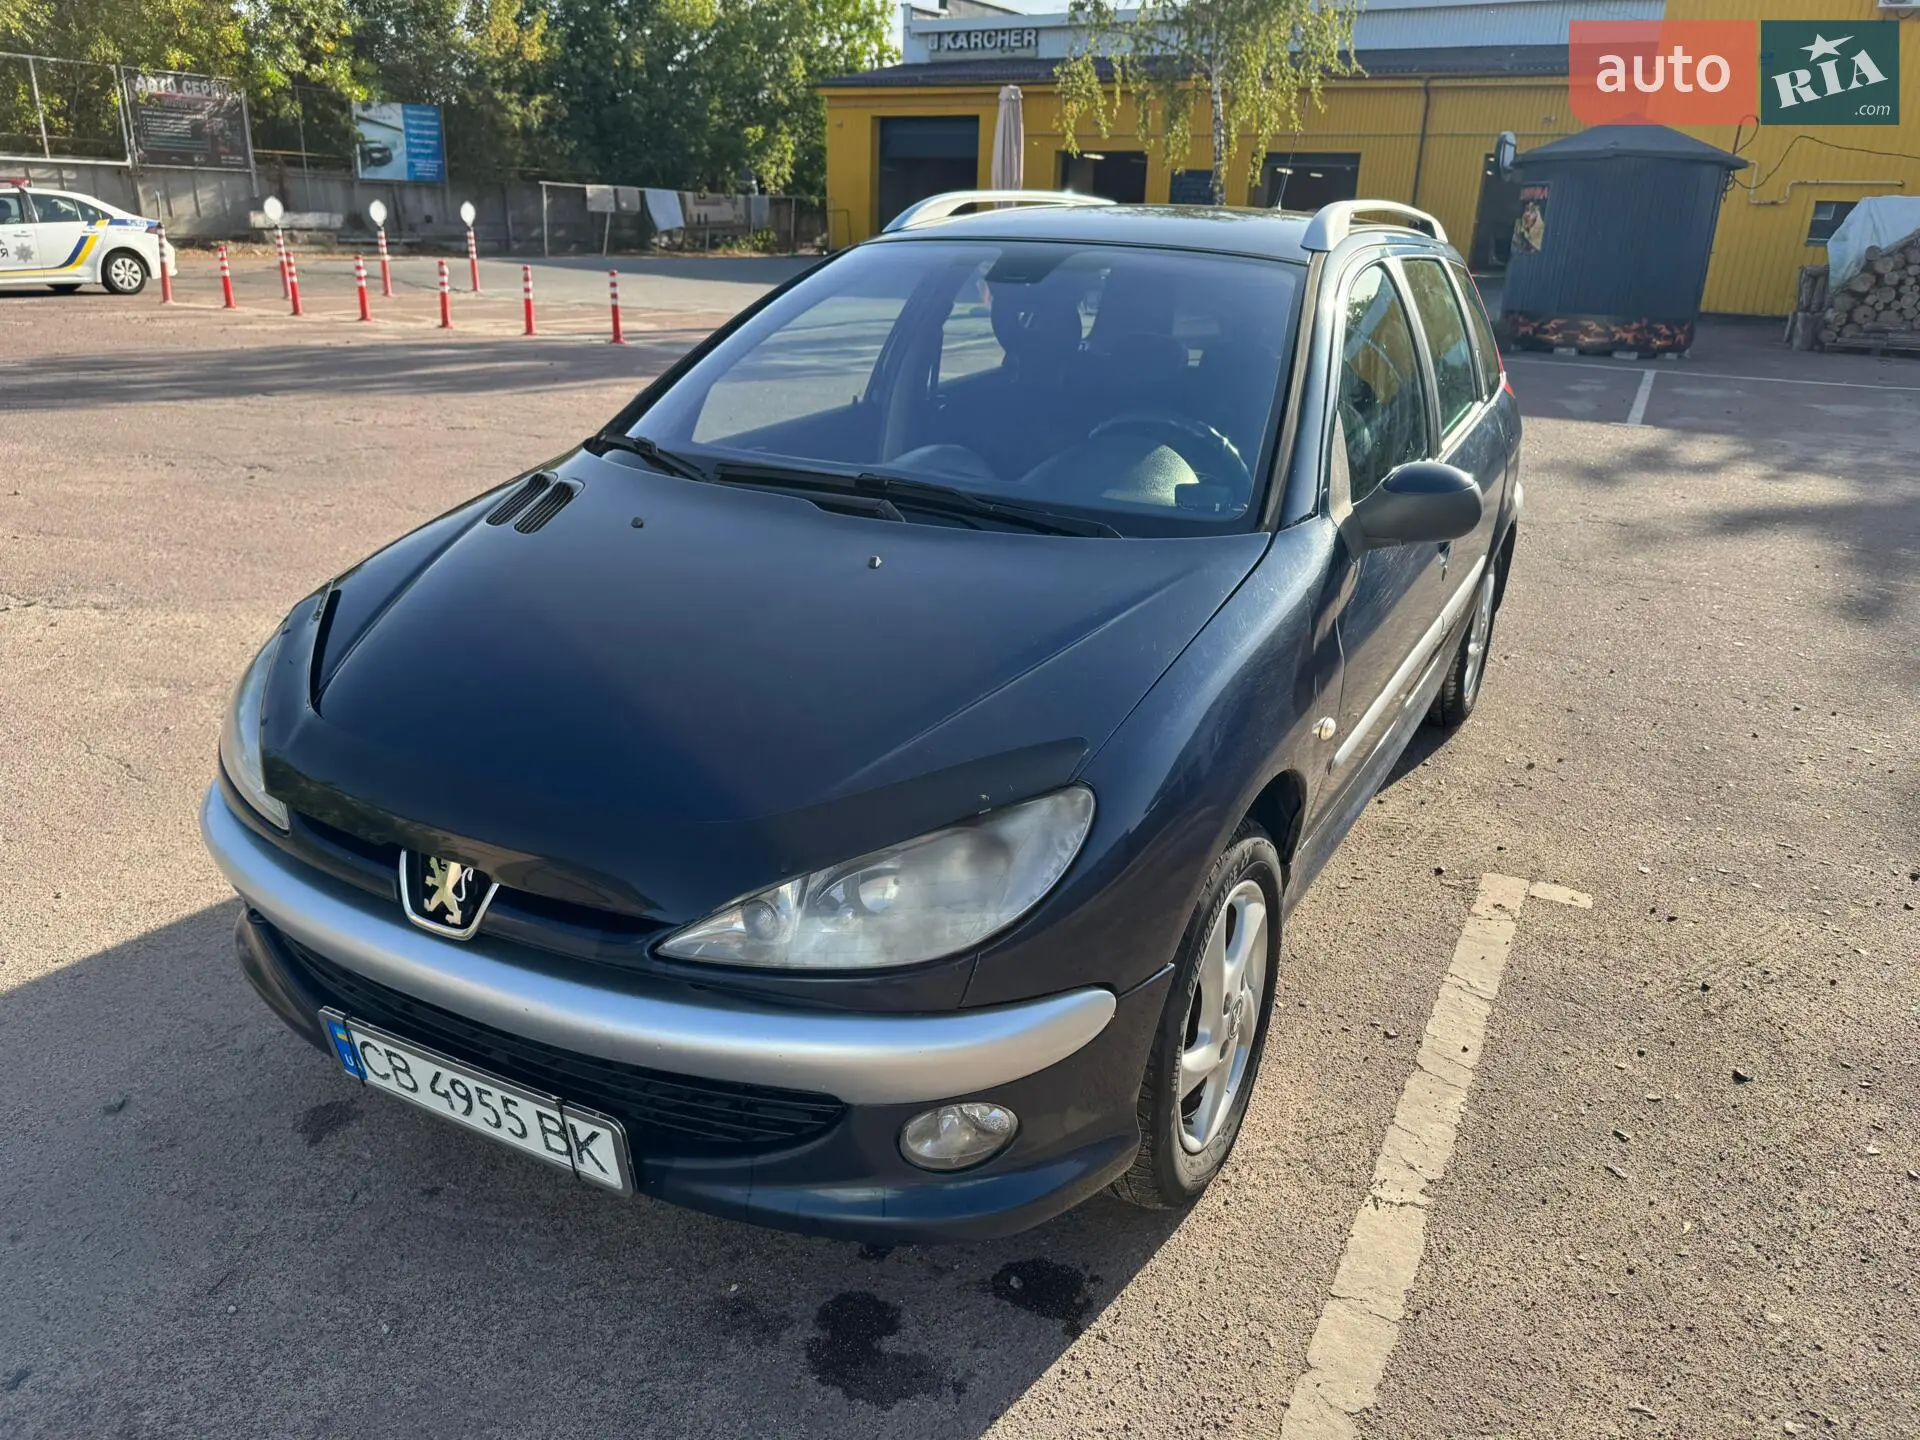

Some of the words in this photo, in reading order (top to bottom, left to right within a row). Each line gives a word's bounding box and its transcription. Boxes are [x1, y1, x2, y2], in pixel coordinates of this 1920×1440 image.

[359, 1040, 419, 1093] CB
[429, 1070, 528, 1140] 4955
[536, 1109, 609, 1175] BK
